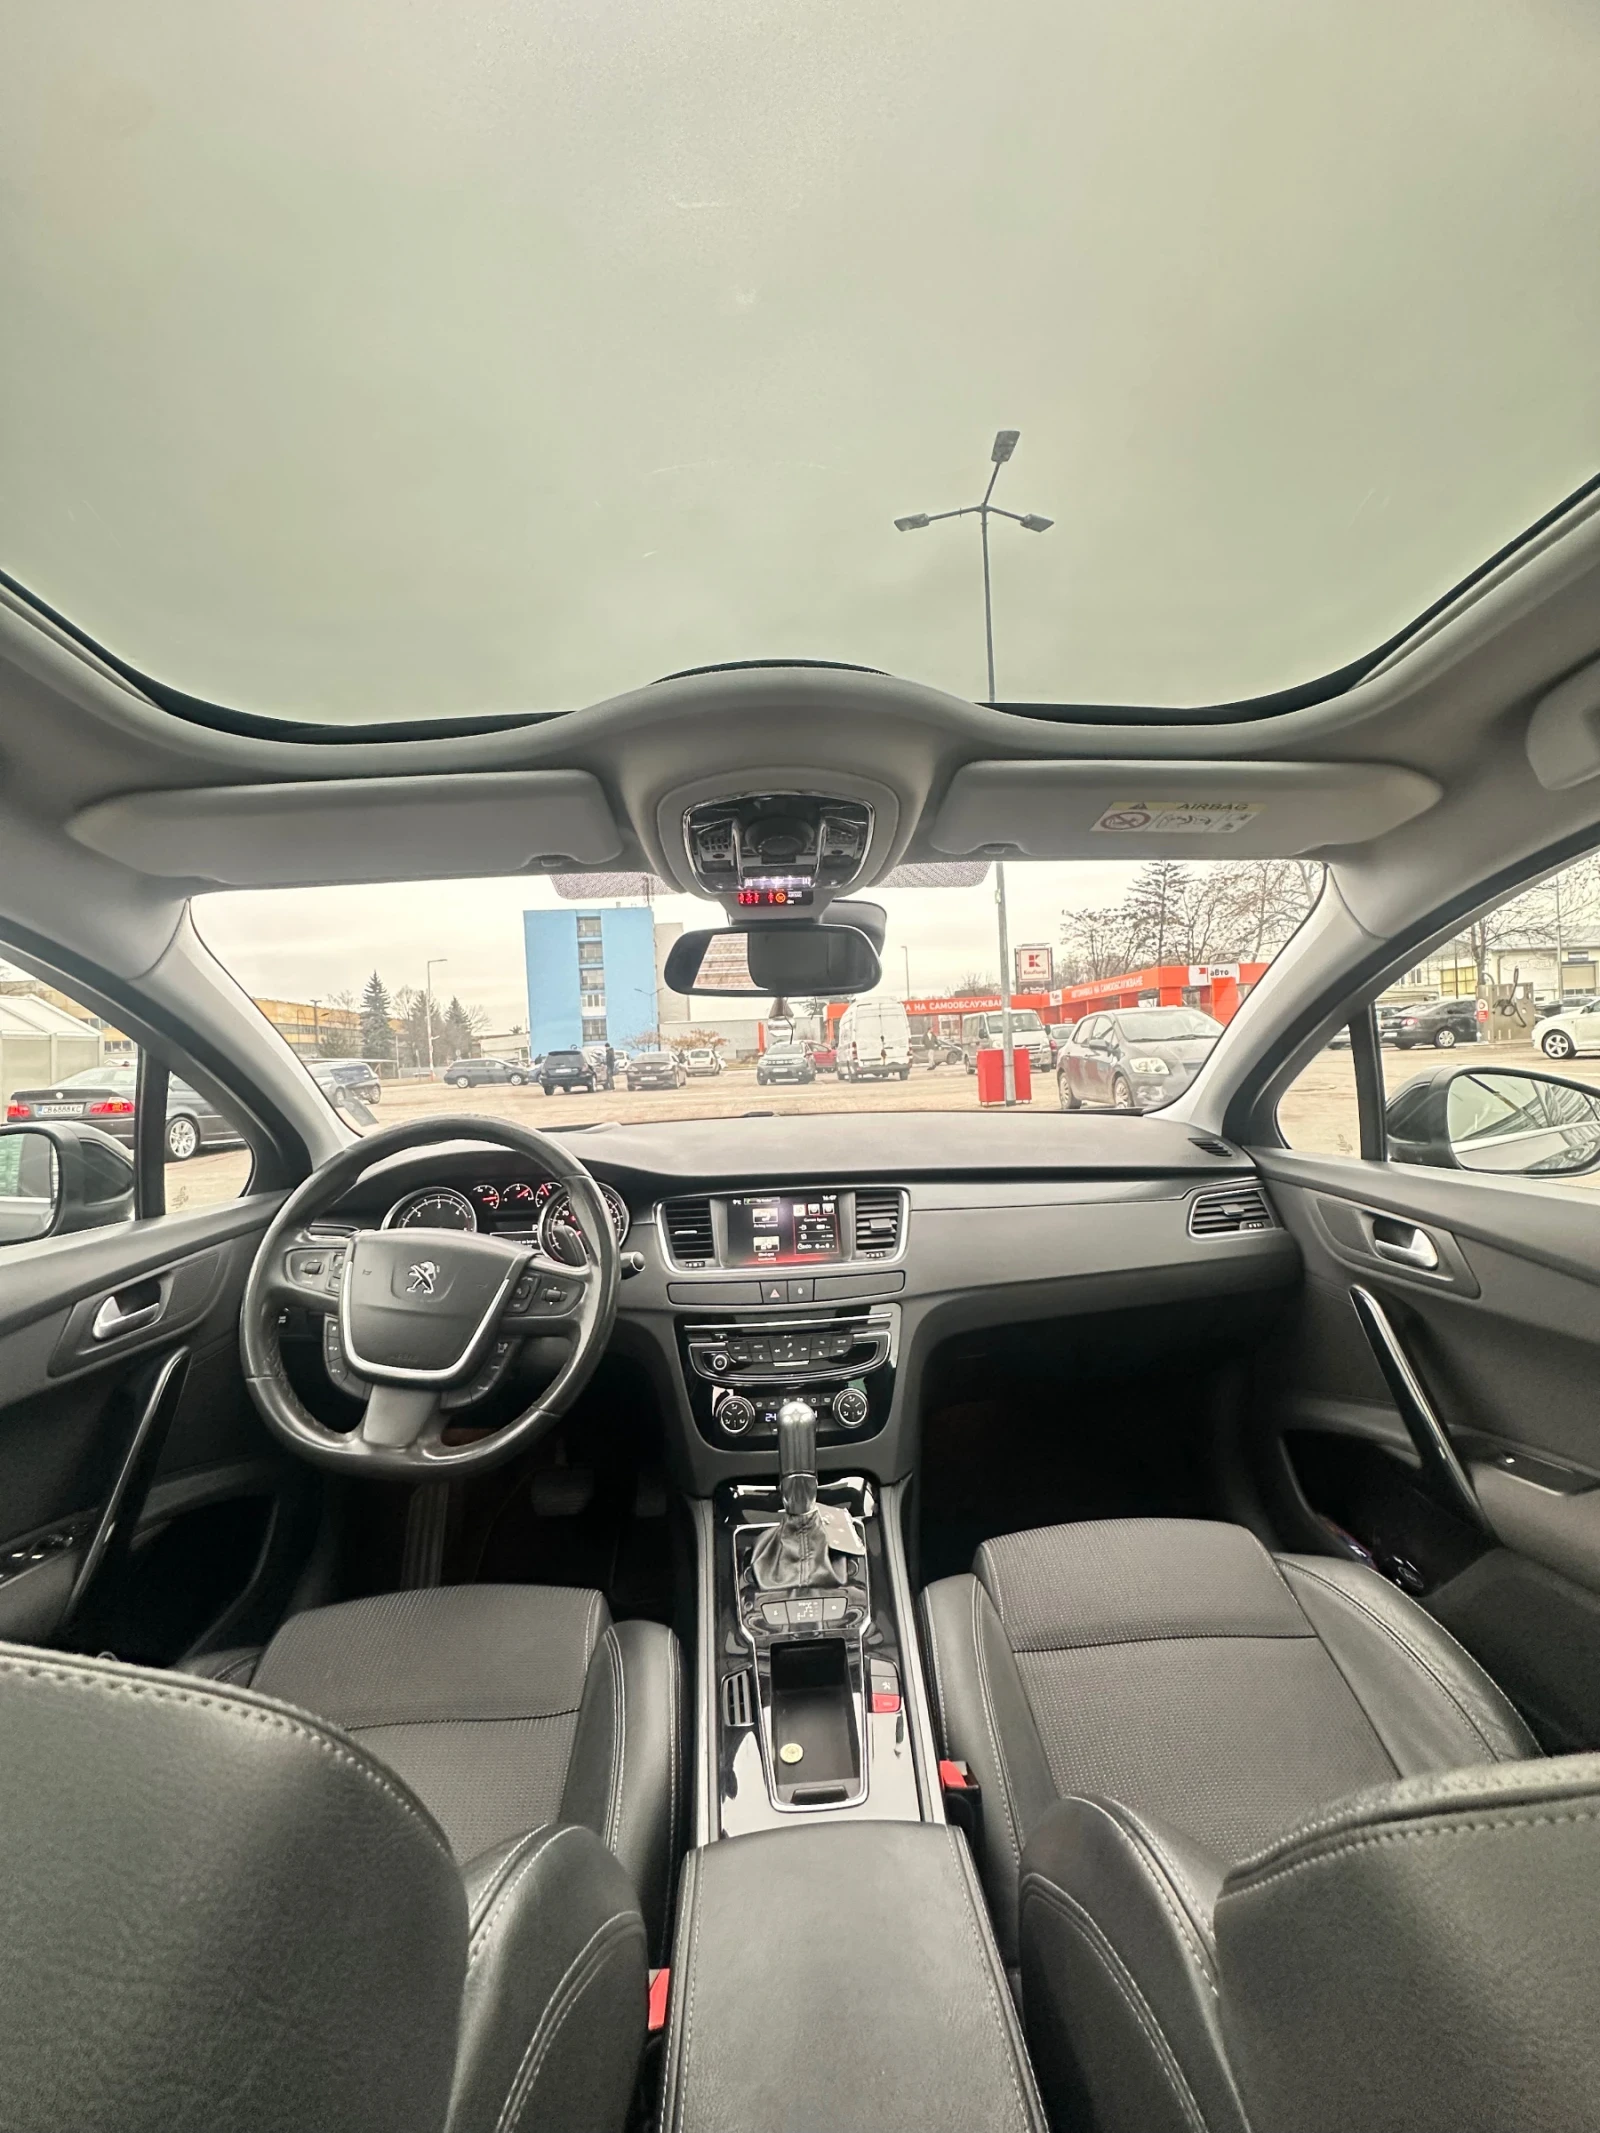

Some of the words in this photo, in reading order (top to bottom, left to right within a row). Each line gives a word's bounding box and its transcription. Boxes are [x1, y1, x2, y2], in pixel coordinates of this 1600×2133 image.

[1210, 968, 1229, 976] авто
[914, 1003, 927, 1011] НА
[765, 1413, 777, 1422] 24
